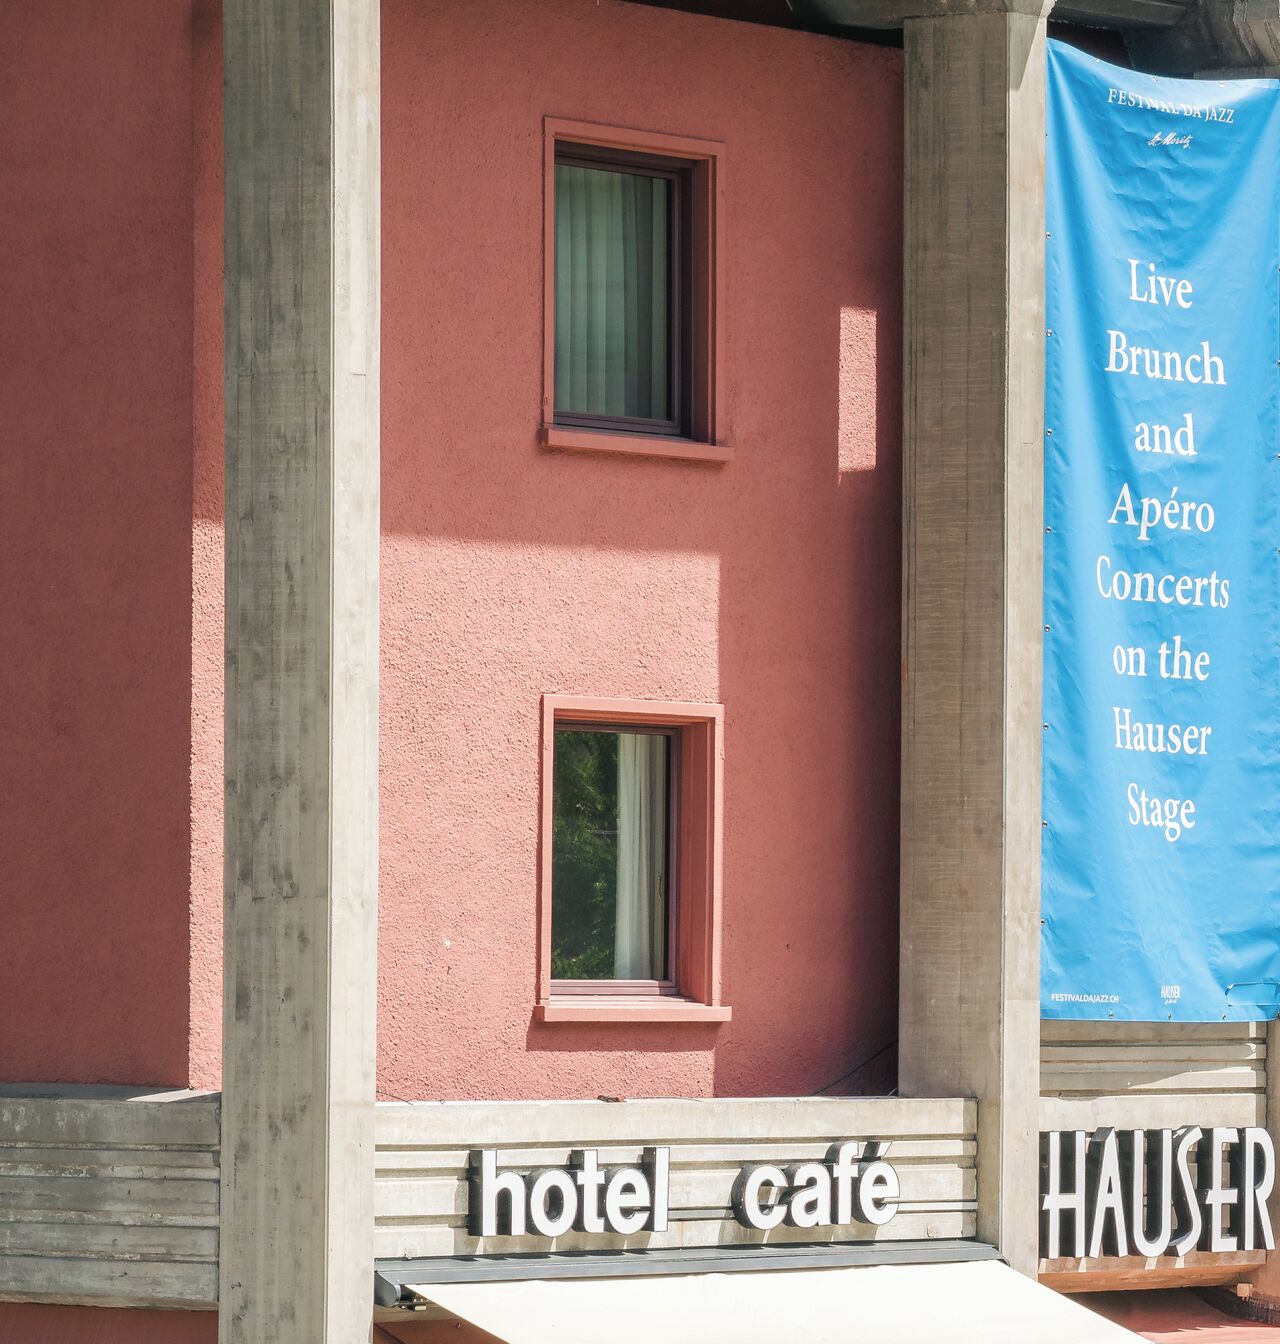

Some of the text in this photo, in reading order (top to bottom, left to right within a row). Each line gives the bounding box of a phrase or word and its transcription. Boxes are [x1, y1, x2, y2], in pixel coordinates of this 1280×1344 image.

[1107, 88, 1235, 124] FESTIVAL DA JAZZ
[1128, 258, 1194, 309] Live
[1105, 329, 1227, 386] Brunch
[1135, 413, 1197, 457] and
[1108, 482, 1216, 541] Apéro
[1095, 554, 1230, 609] Concerts
[1113, 635, 1211, 682] on the
[1113, 706, 1212, 755] Hauser
[1127, 782, 1196, 842] Stage
[1051, 993, 1119, 1004] FESTIVALDAJAZZ.CH
[470, 1146, 670, 1238] hotel
[740, 1139, 901, 1230] café
[1043, 1125, 1276, 1259] HAUSER
